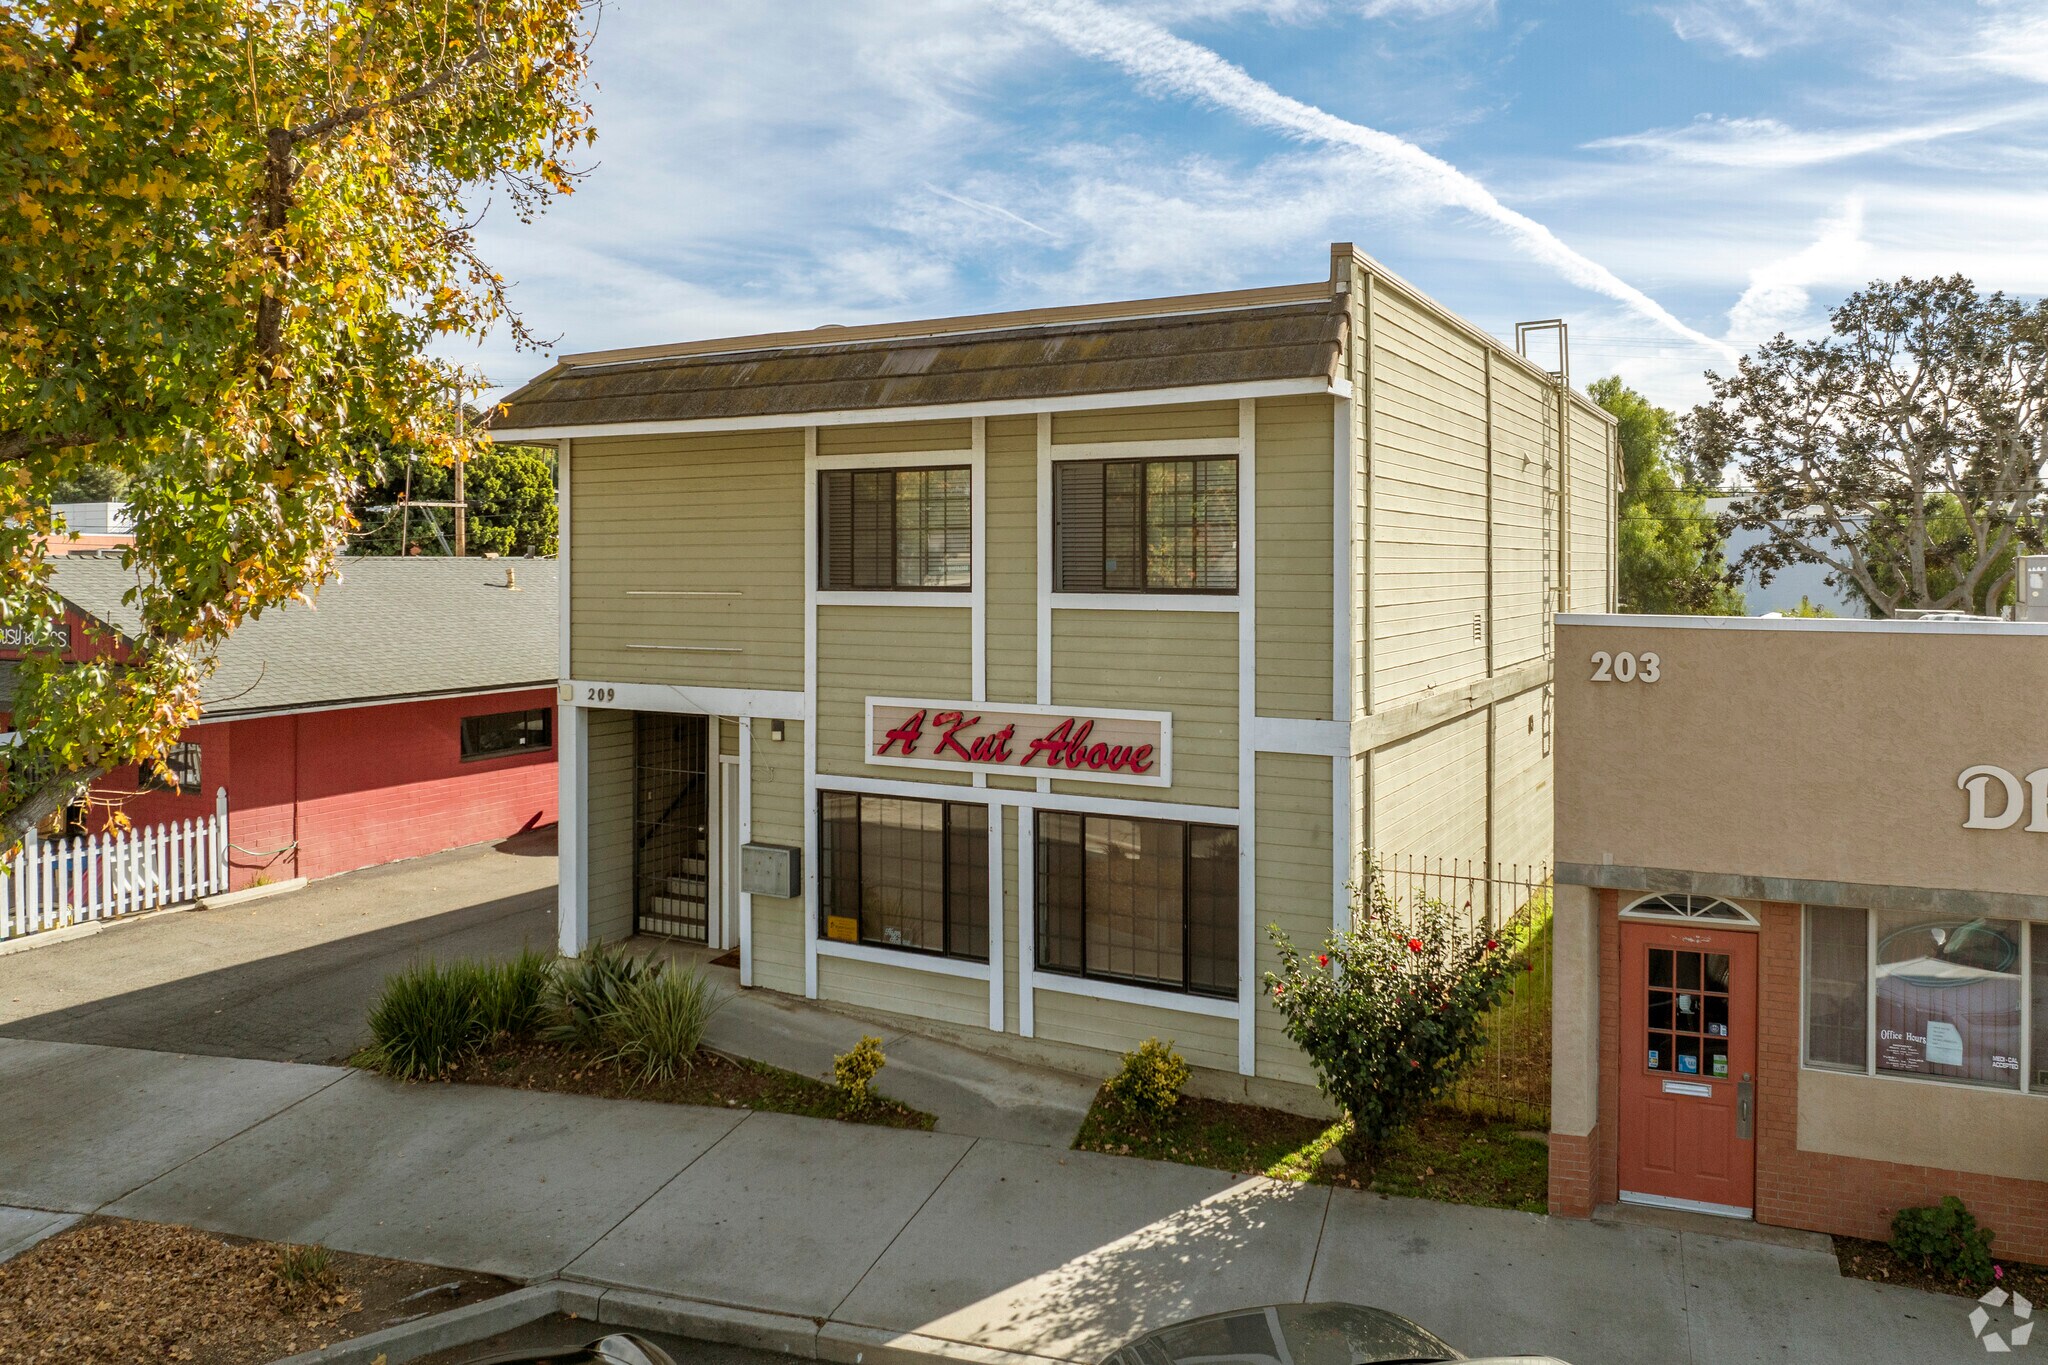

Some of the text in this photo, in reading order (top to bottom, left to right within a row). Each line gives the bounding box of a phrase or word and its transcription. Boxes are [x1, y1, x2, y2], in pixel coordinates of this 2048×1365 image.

[1590, 651, 1660, 683] 203
[588, 688, 615, 702] 209
[877, 709, 1153, 774] A Kut Above
[1880, 1029, 1903, 1040] Office
[1906, 1032, 1927, 1044] Hours
